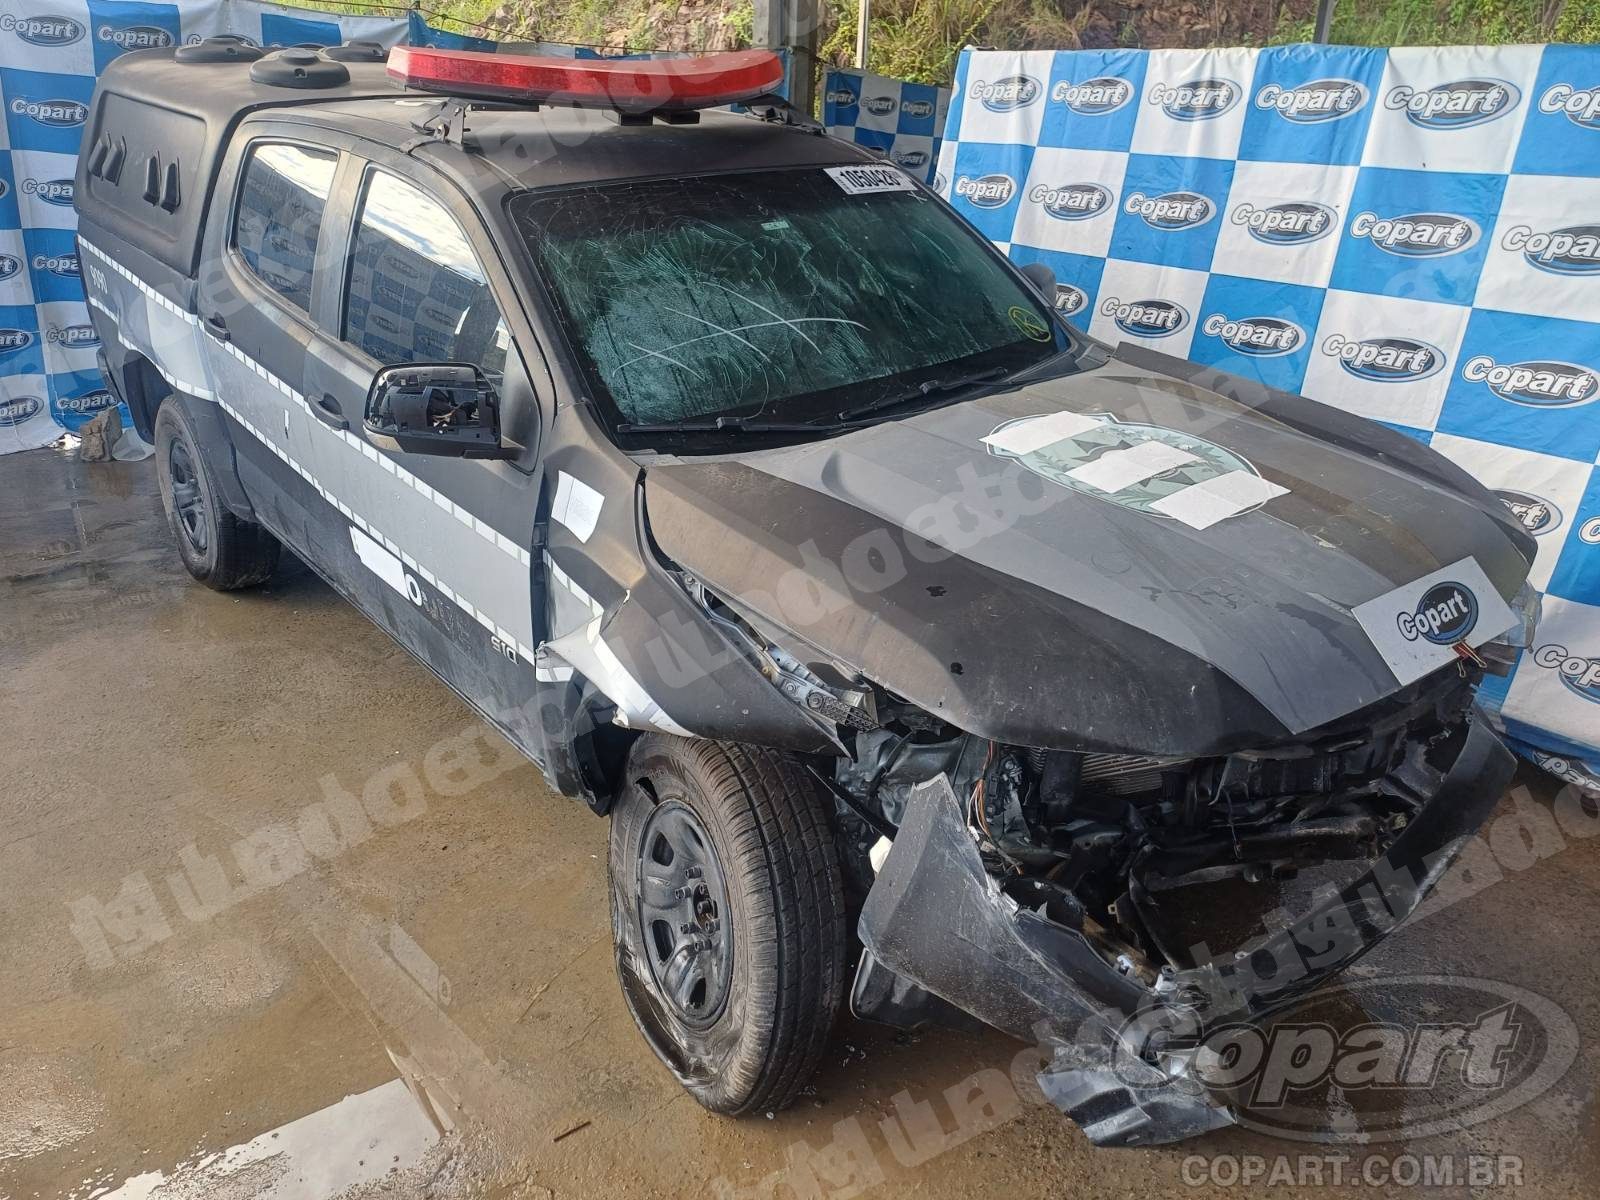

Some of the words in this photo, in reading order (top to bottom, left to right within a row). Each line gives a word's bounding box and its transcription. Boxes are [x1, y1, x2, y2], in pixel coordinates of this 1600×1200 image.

[0, 14, 77, 38] Copart
[98, 25, 168, 47] Copart
[1052, 79, 1127, 108] Copart
[1147, 81, 1233, 112] Copart
[1255, 84, 1360, 117] Copart
[1383, 85, 1503, 118] Copart
[1538, 83, 1600, 120] Cop
[11, 98, 84, 121] Copart
[22, 178, 73, 199] Copa
[955, 176, 1010, 203] Copart
[1029, 184, 1103, 212] Copart
[1123, 192, 1206, 222] Copart
[1231, 203, 1330, 234] Copart
[1350, 211, 1468, 250] Copart
[1502, 225, 1600, 260] Copa
[1101, 297, 1179, 329] Copart
[1202, 314, 1296, 350] Copart
[1321, 334, 1431, 373] Copart
[1462, 355, 1594, 400] Copart
[1397, 590, 1470, 642] Copart
